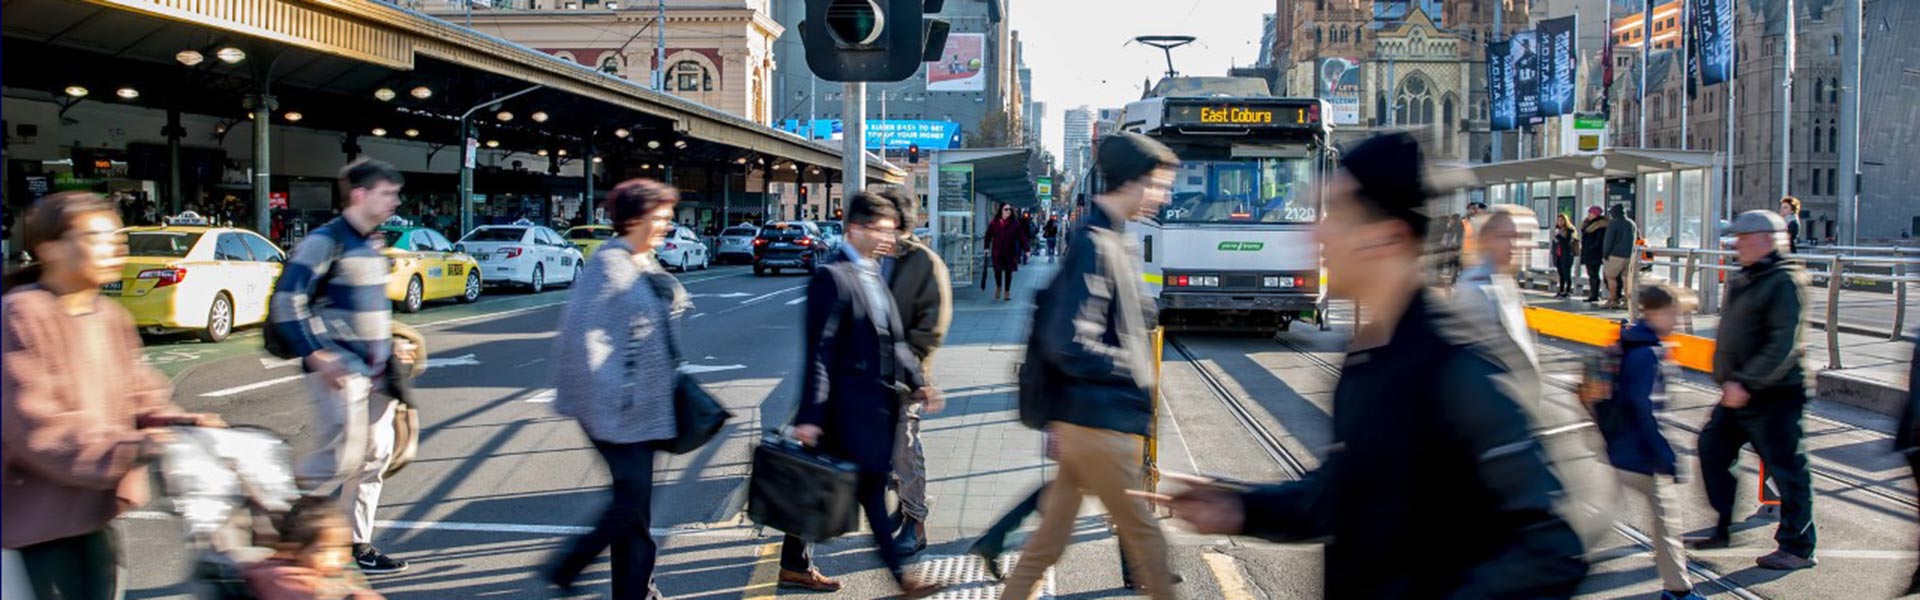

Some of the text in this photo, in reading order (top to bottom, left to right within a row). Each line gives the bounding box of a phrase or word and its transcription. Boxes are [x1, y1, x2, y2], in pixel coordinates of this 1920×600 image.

[1201, 107, 1305, 124] East Coburg 1
[1284, 207, 1316, 220] 2120
